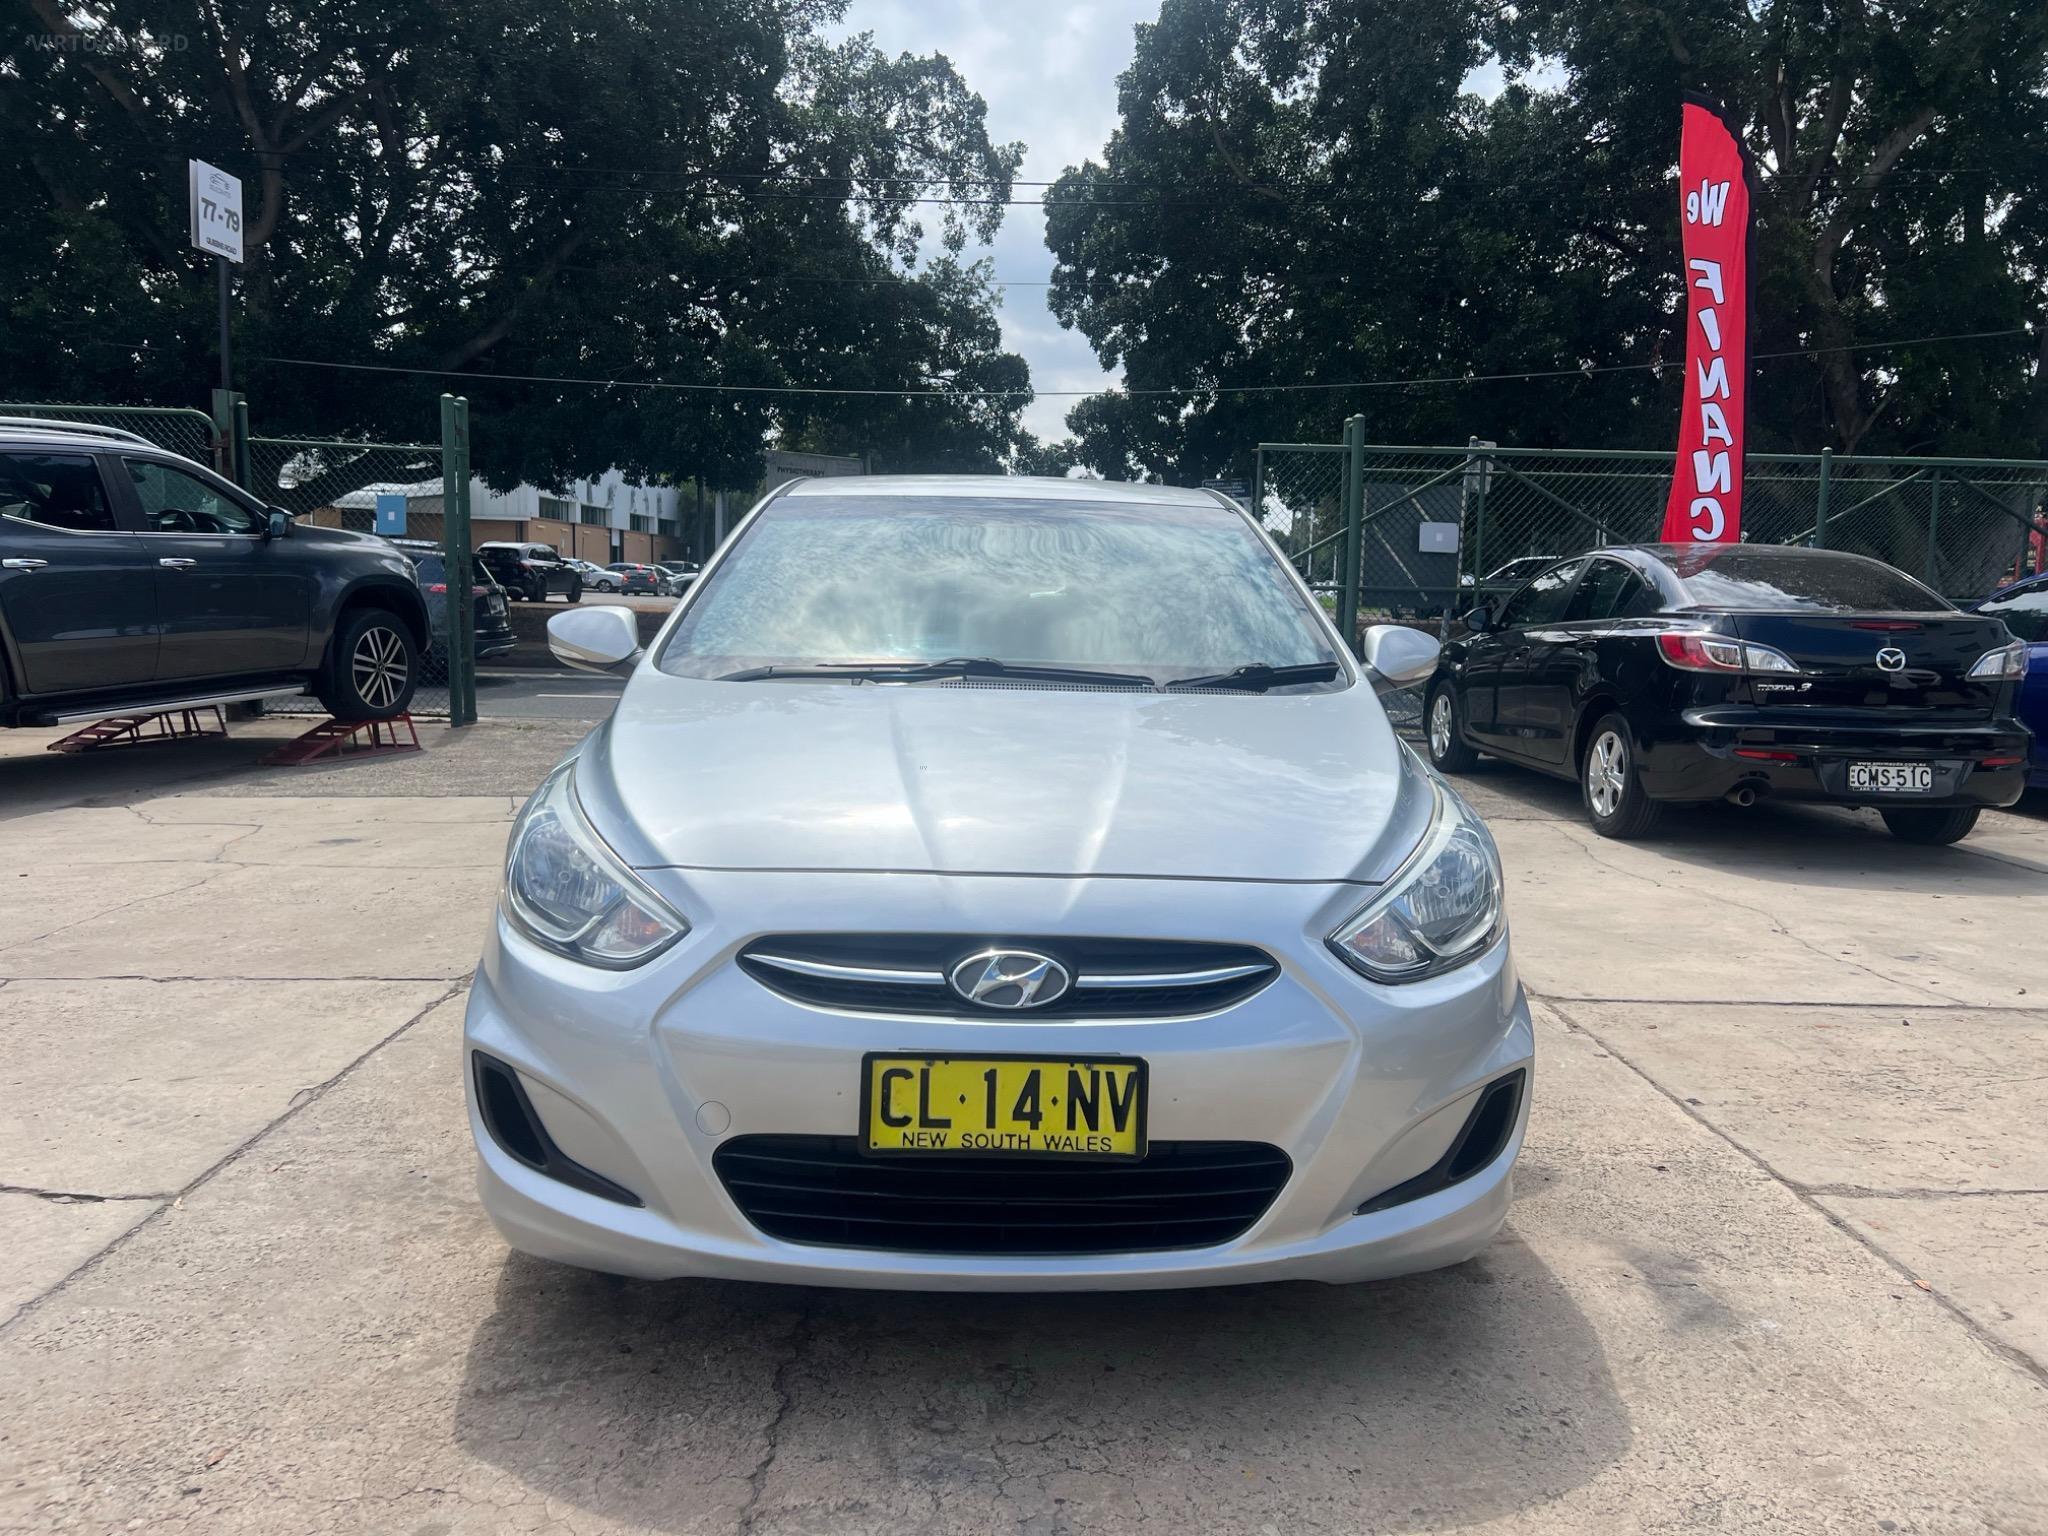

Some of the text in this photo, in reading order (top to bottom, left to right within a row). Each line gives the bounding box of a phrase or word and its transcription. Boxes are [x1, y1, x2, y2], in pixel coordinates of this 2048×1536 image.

[902, 1132, 1113, 1152] NEW SOUTH WALES
